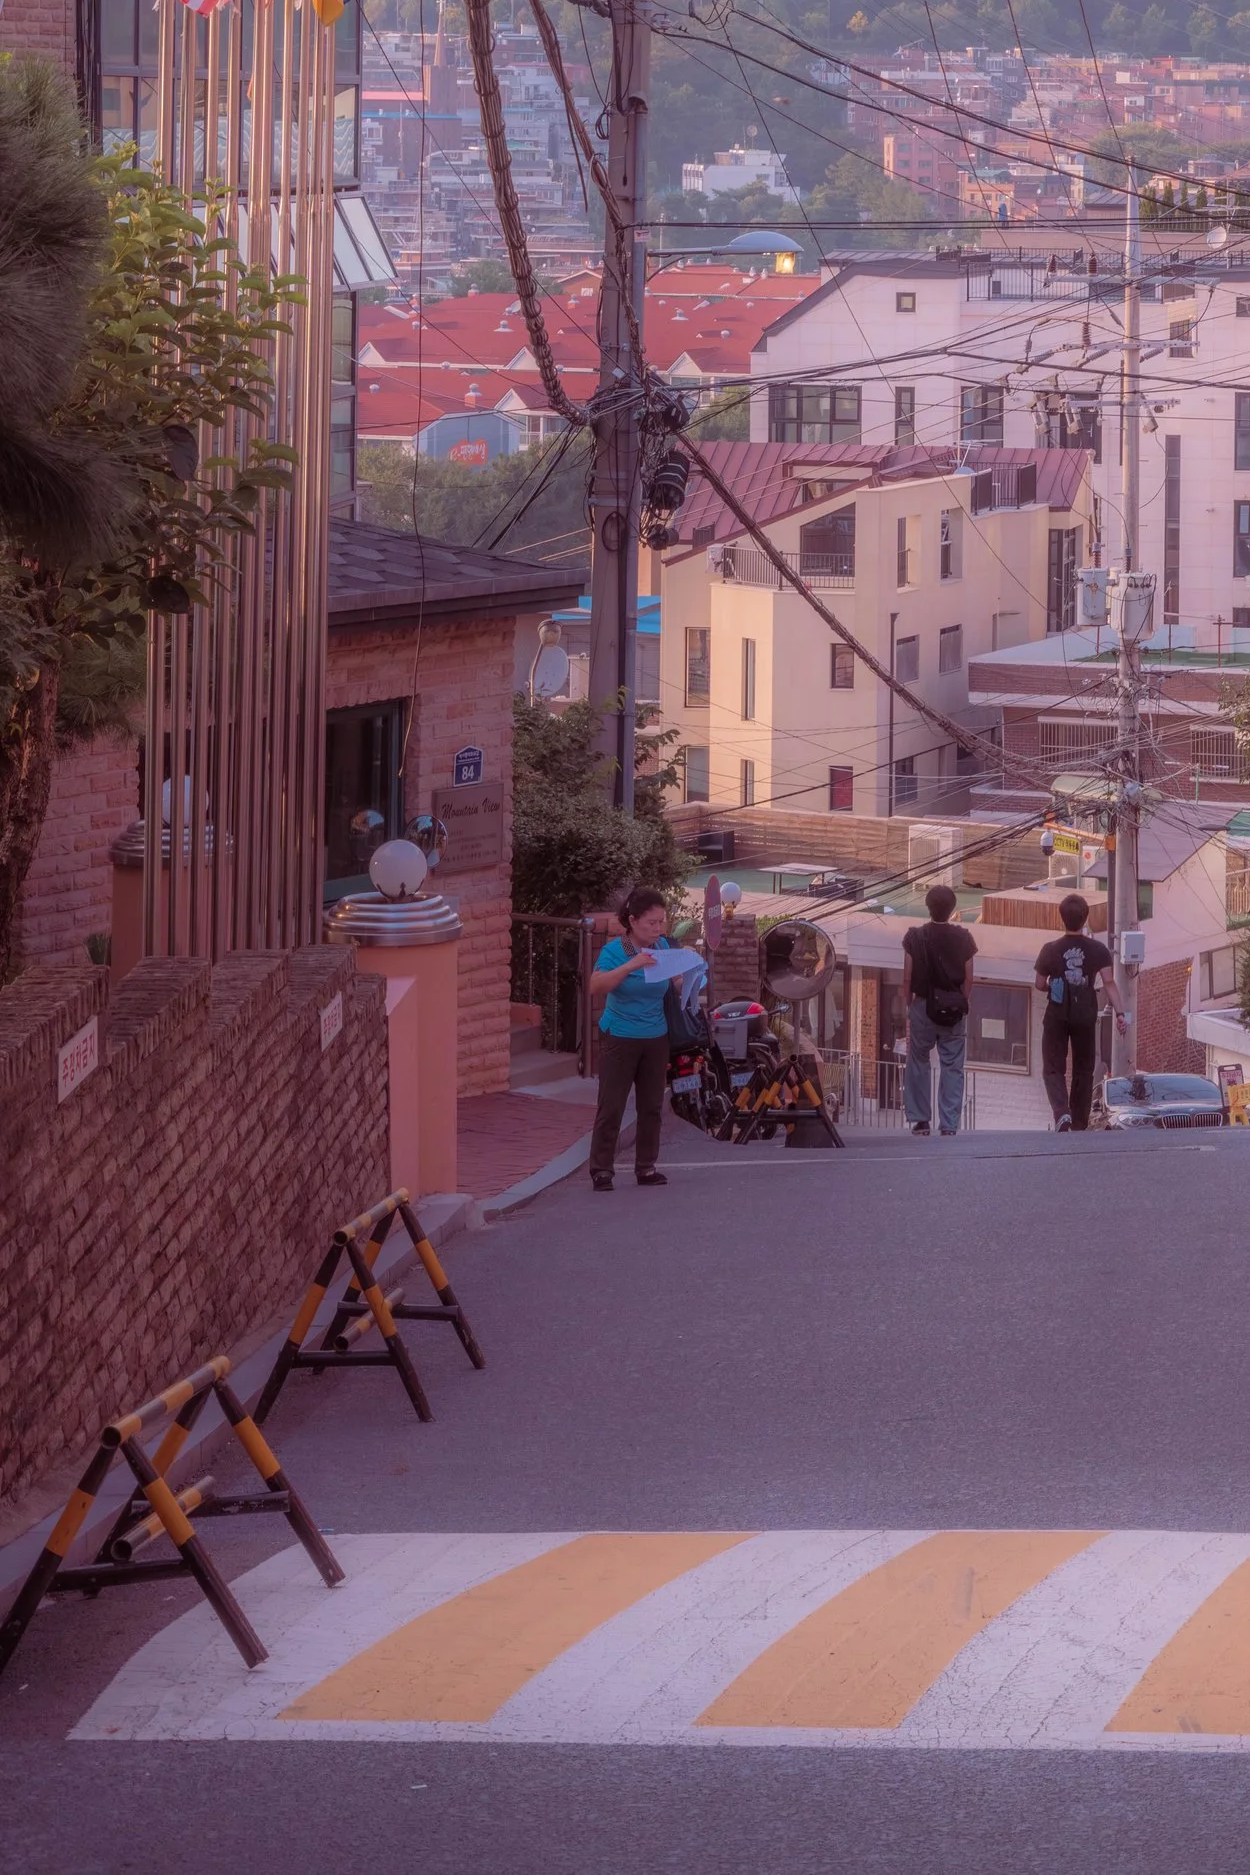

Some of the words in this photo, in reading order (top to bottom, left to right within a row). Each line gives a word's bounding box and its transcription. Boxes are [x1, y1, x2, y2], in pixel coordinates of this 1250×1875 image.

[461, 765, 474, 780] 84
[441, 803, 478, 819] Mountain
[482, 797, 500, 813] View
[62, 1028, 95, 1088] 주정차금지
